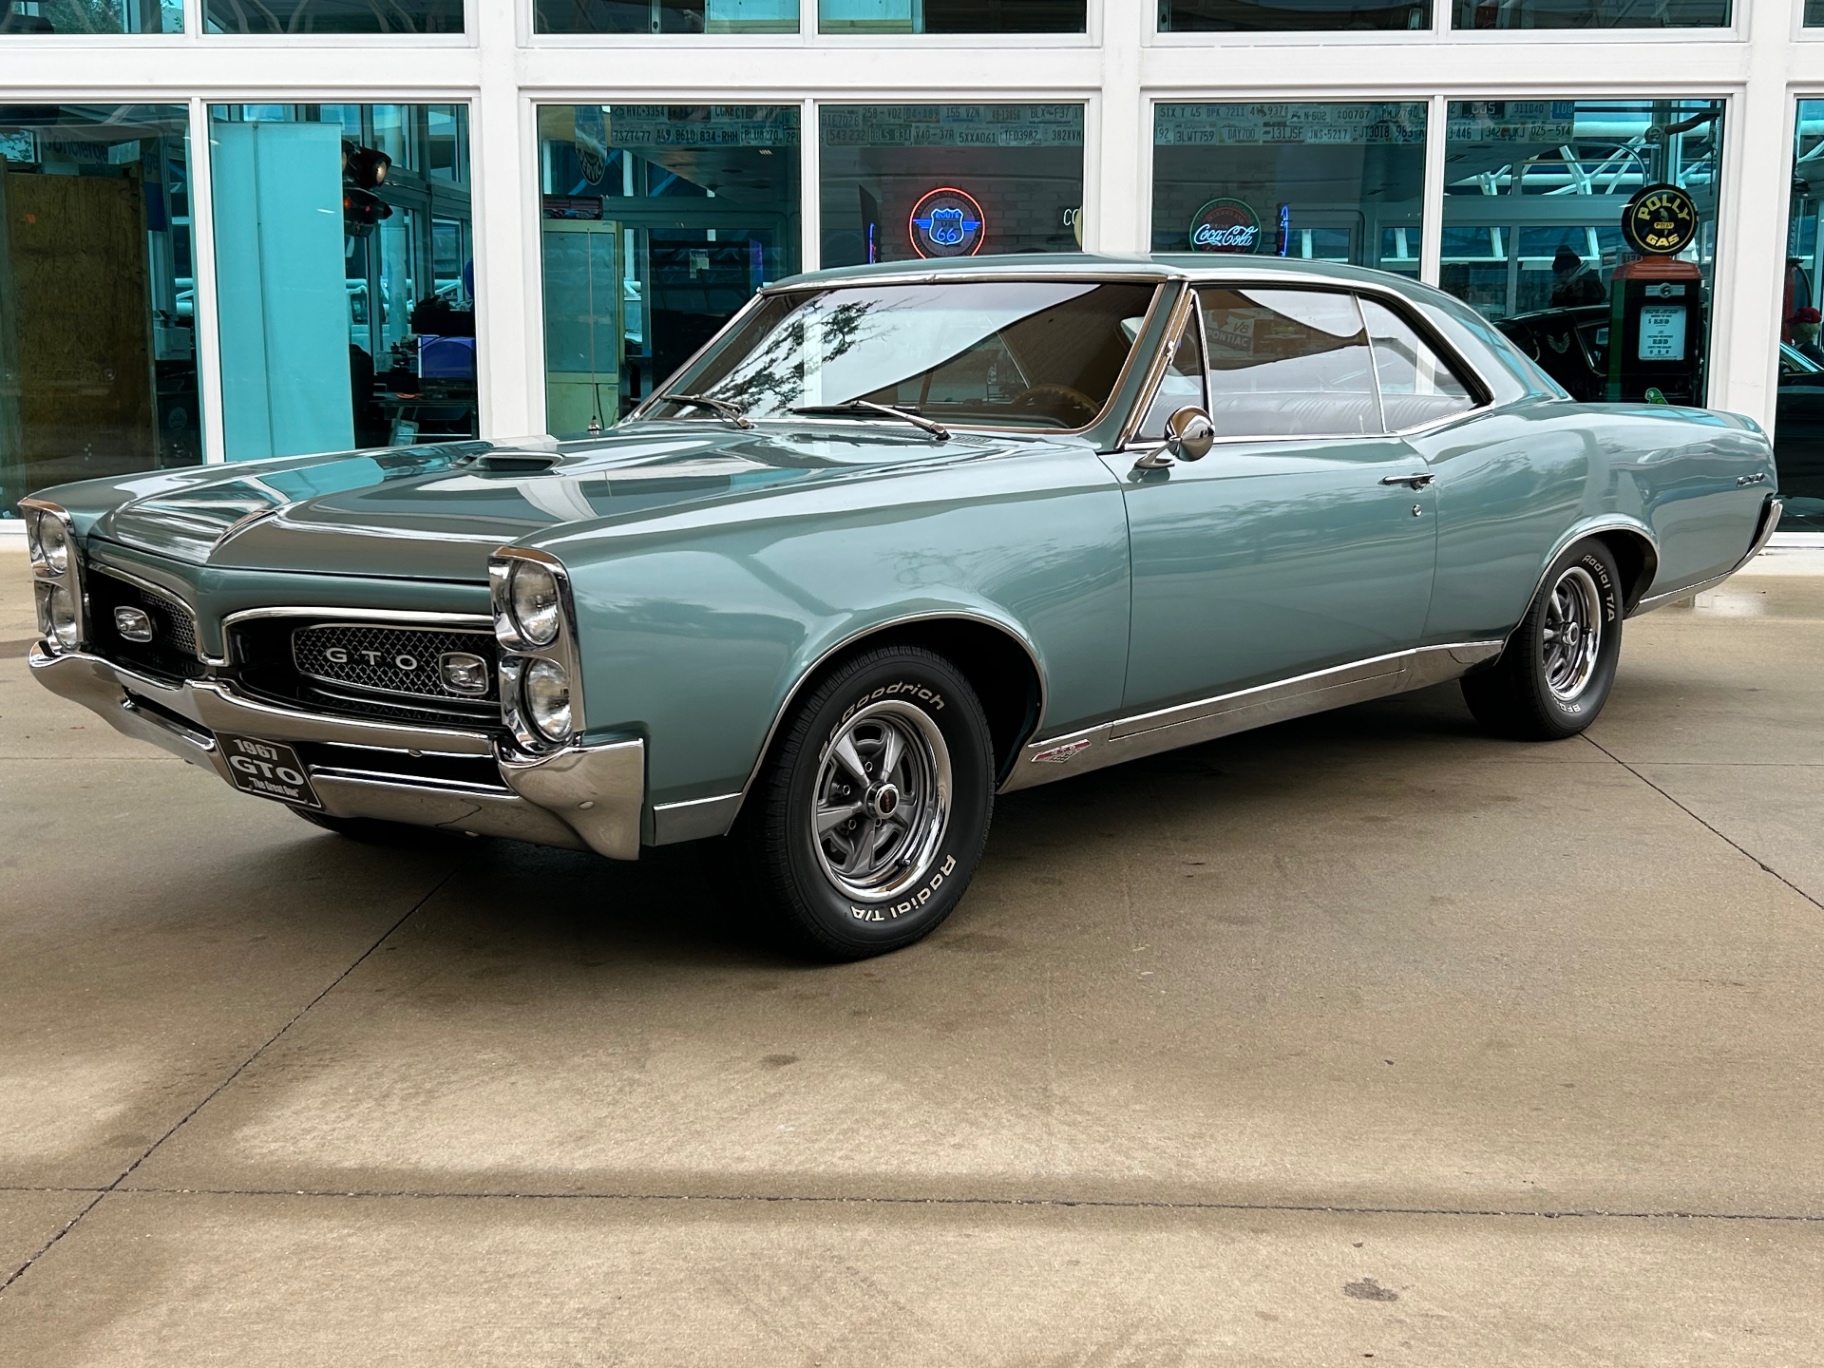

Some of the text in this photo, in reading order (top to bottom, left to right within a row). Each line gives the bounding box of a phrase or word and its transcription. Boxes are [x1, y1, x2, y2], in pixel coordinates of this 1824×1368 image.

[1637, 194, 1690, 220] POLLY
[936, 227, 957, 242] 66
[1193, 223, 1259, 246] Coca-Cola
[1646, 233, 1680, 246] GAS
[1206, 329, 1249, 347] PONTIAC
[1581, 554, 1611, 589] Radial
[325, 647, 418, 670] GTO
[233, 739, 278, 761] 1967
[229, 755, 304, 785] GTO
[850, 854, 957, 921] Radial T/A
